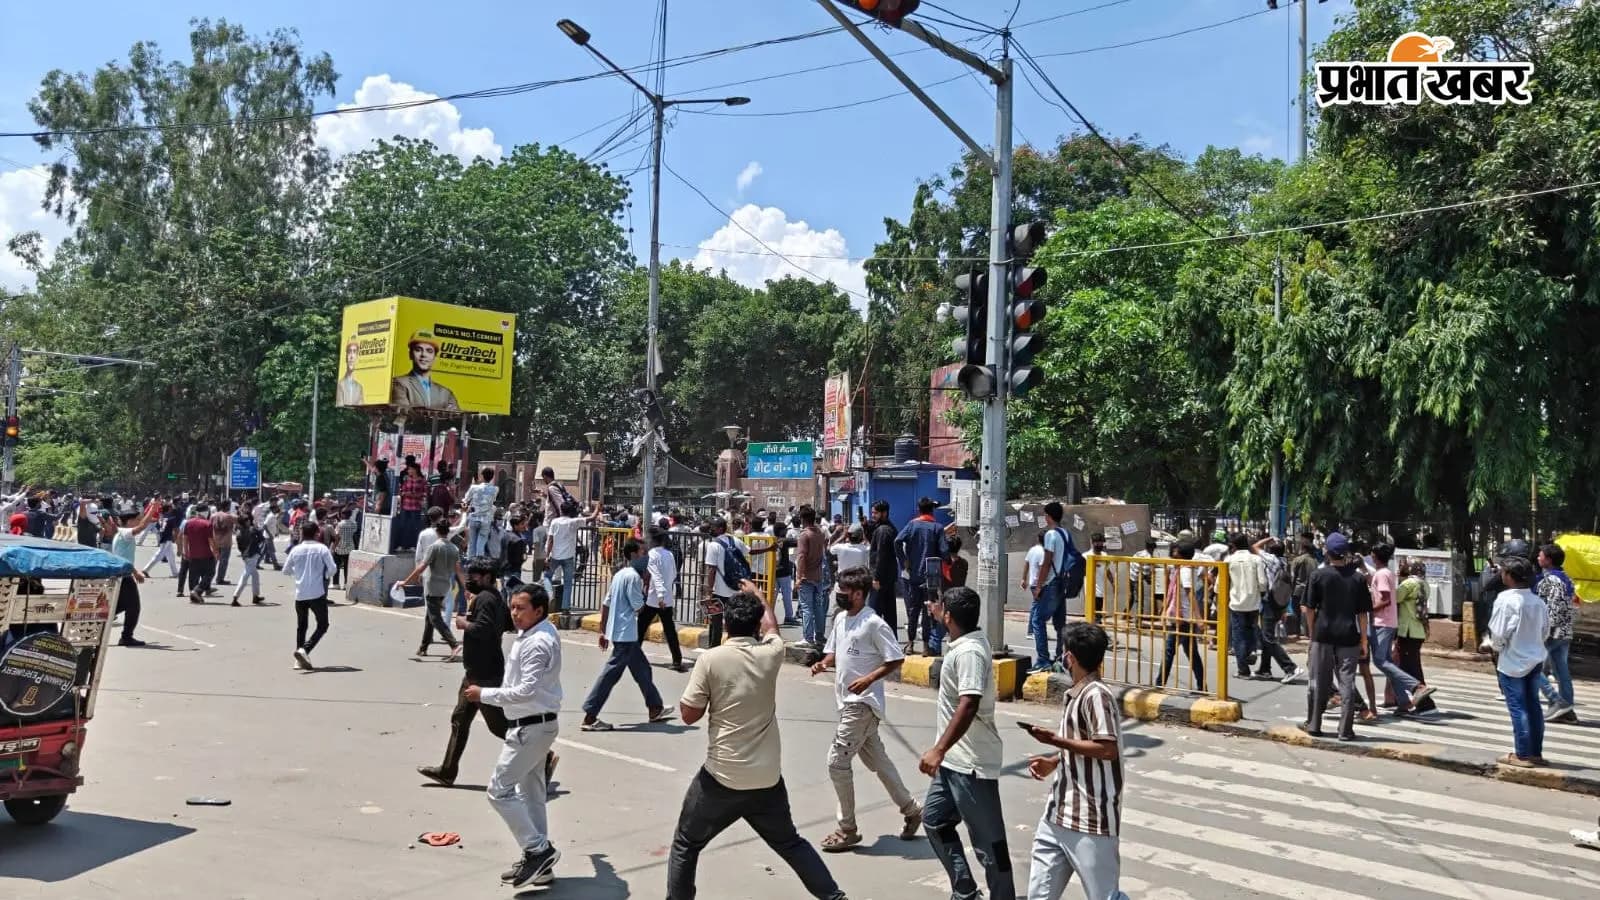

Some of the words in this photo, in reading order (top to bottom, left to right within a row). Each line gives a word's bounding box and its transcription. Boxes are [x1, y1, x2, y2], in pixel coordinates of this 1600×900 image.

[435, 327, 460, 337] INDIA'S
[476, 333, 502, 342] CEMENT
[441, 342, 496, 358] UltraTech
[754, 458, 771, 473] गेट
